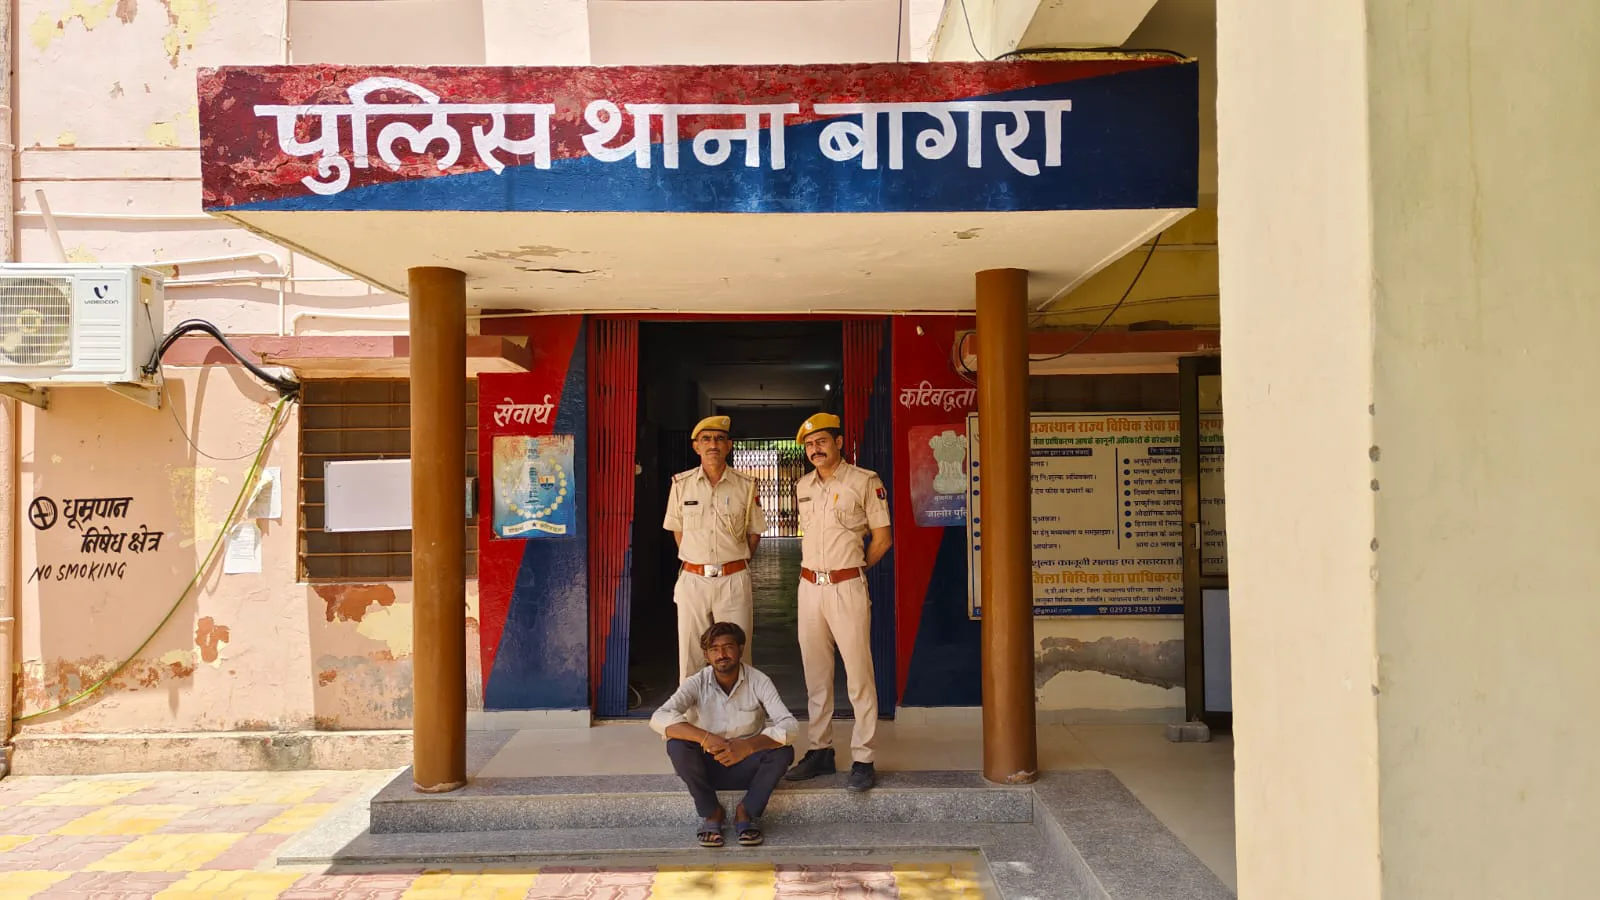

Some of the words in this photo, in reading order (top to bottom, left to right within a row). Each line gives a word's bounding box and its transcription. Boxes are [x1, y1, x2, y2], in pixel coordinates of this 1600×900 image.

[254, 76, 555, 196] पुलिस
[582, 99, 800, 171] थाना
[813, 98, 1073, 176] बागरा
[494, 394, 555, 427] सेवार्थ
[1078, 421, 1104, 432] राज्य
[1107, 417, 1141, 432] विधिक
[1144, 416, 1166, 432] सेवा
[63, 497, 134, 532] धूम्रपान
[81, 526, 128, 553] निषेध
[128, 524, 164, 553] क्षेत्र
[27, 565, 52, 584] NO
[56, 562, 127, 581] SMOKING
[1057, 557, 1090, 568] कानूनी
[1092, 558, 1119, 566] सलाह
[1137, 558, 1174, 566] सहायता
[1063, 570, 1100, 583] विधिक
[1103, 570, 1125, 583] सेवा
[1032, 606, 1073, 615] @gmail.com
